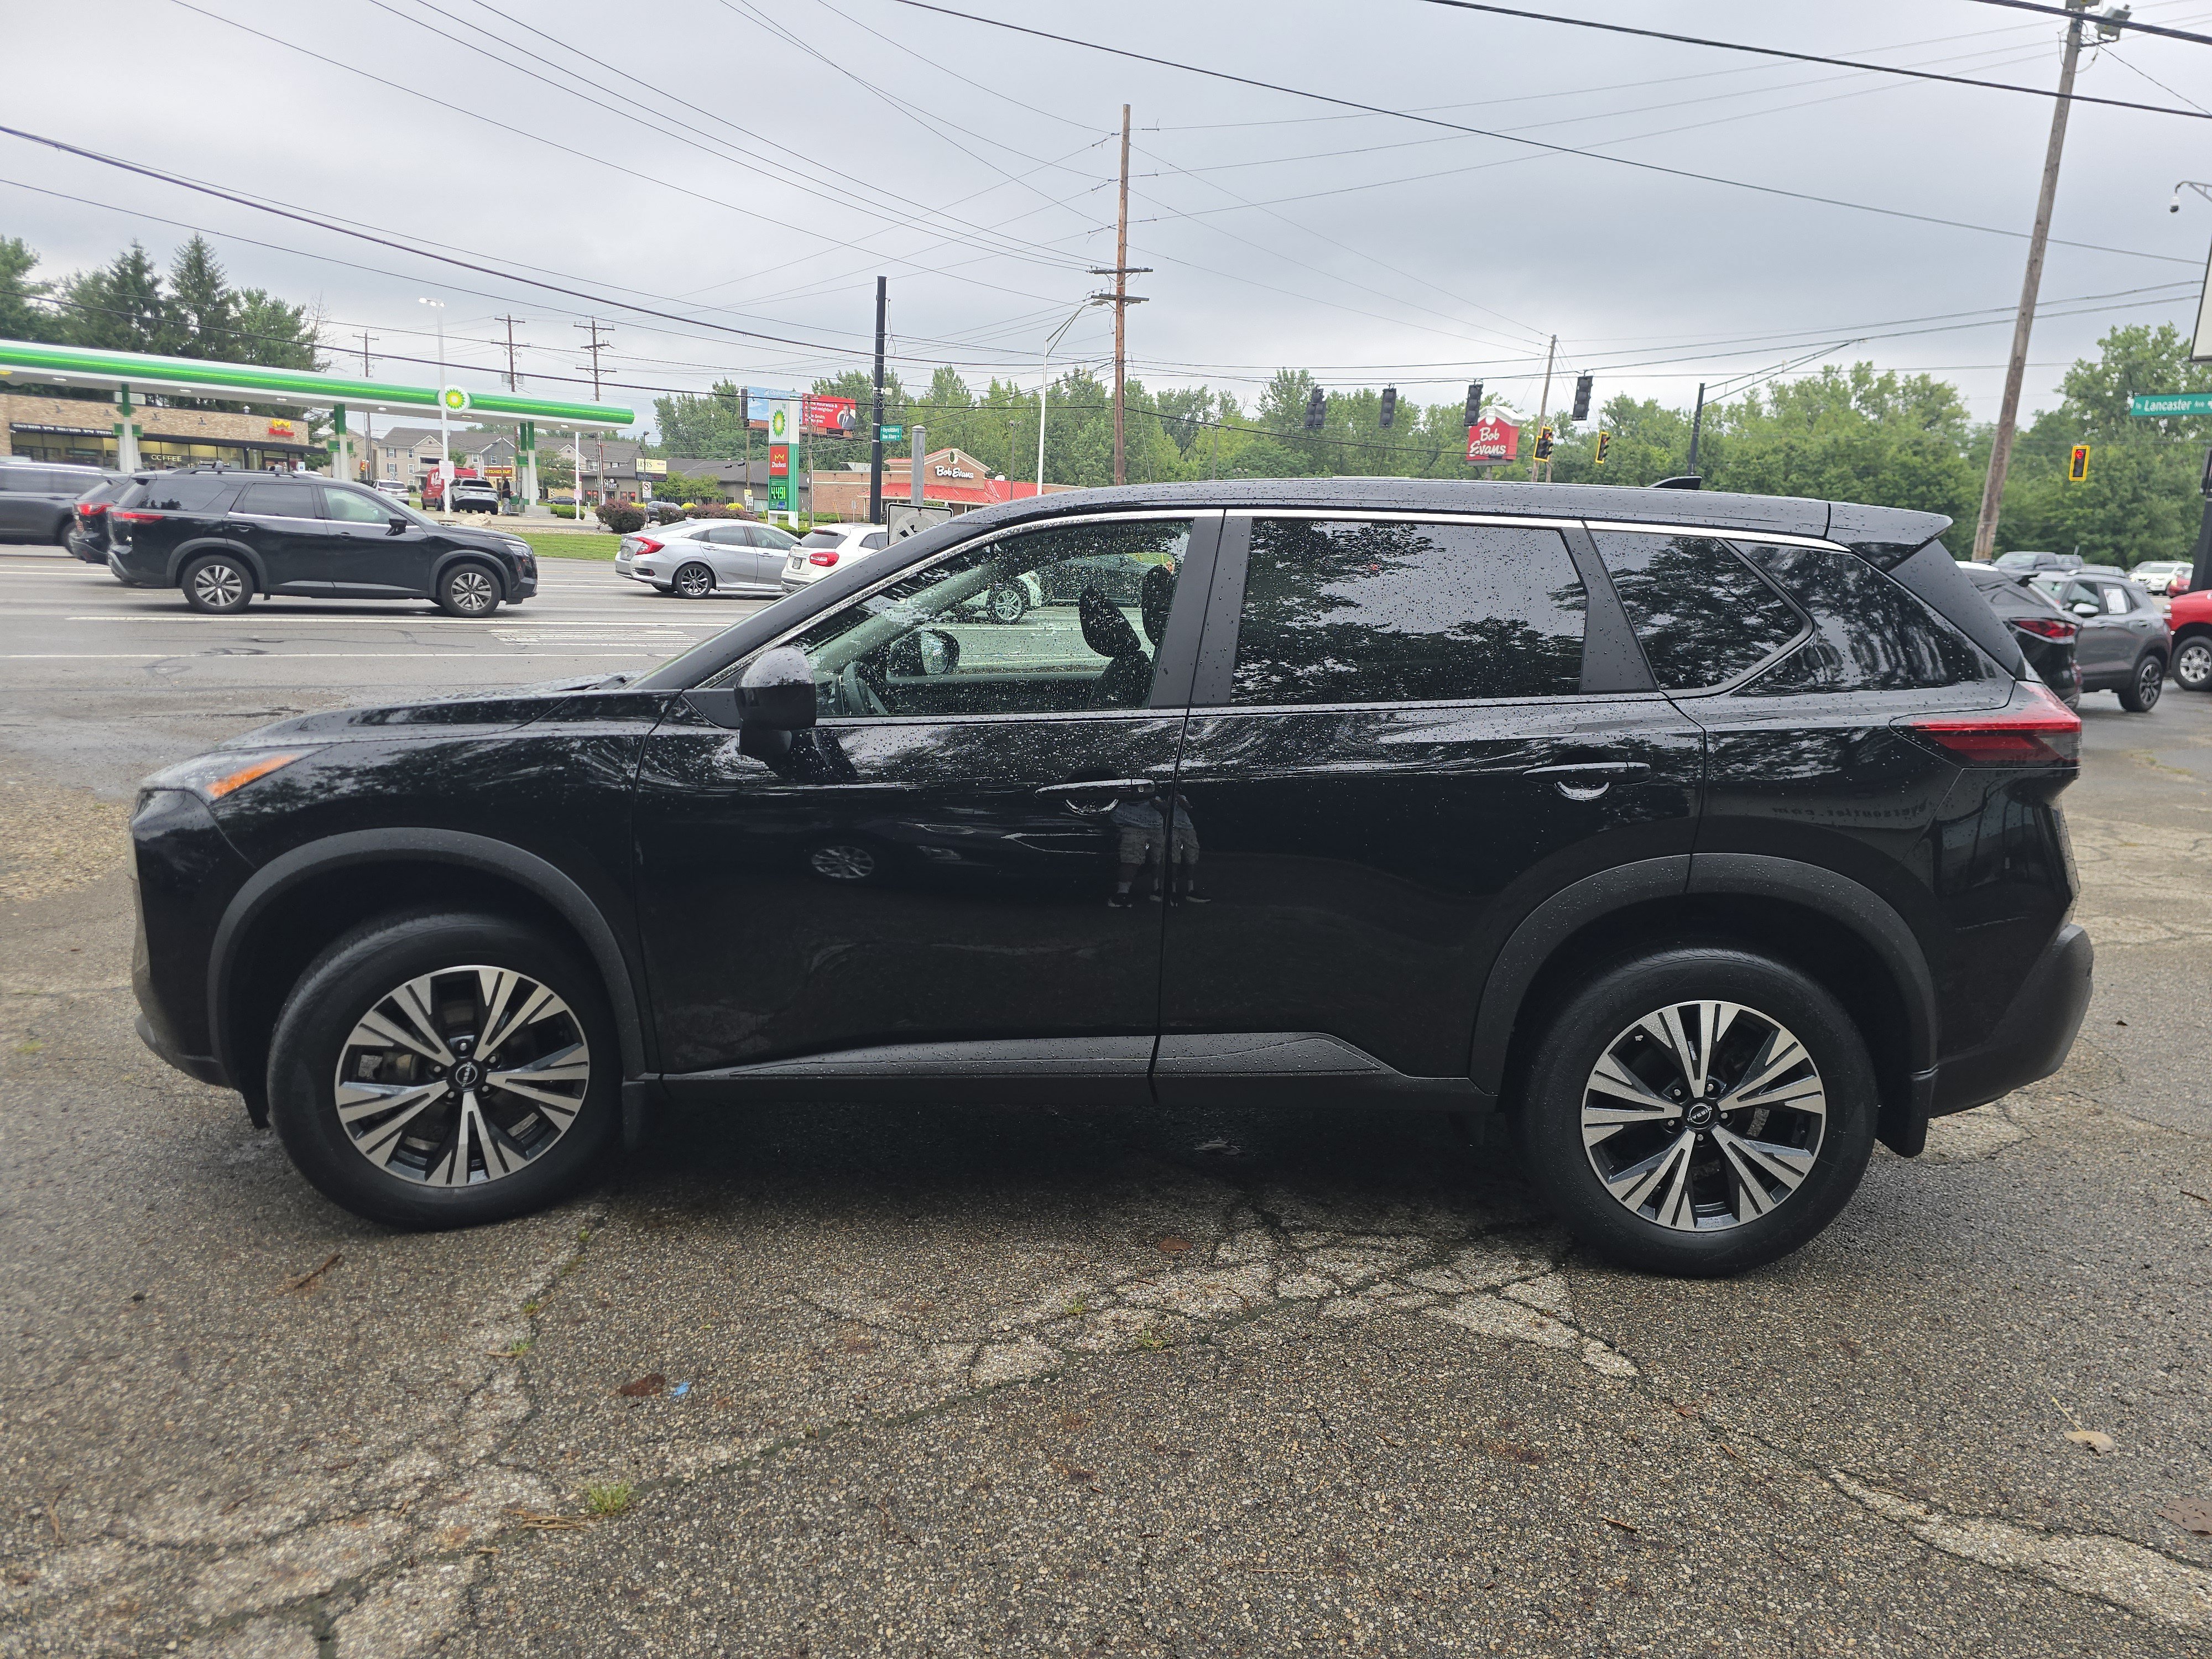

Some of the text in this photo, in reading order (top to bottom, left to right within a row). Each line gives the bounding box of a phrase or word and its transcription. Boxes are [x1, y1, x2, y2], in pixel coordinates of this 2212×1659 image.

[2144, 399, 2192, 412] Lancaster
[1479, 427, 1500, 441] Bob
[1469, 440, 1506, 457] Evans
[935, 465, 974, 478] Bob Evans
[1687, 1106, 1713, 1122] NISSAN
